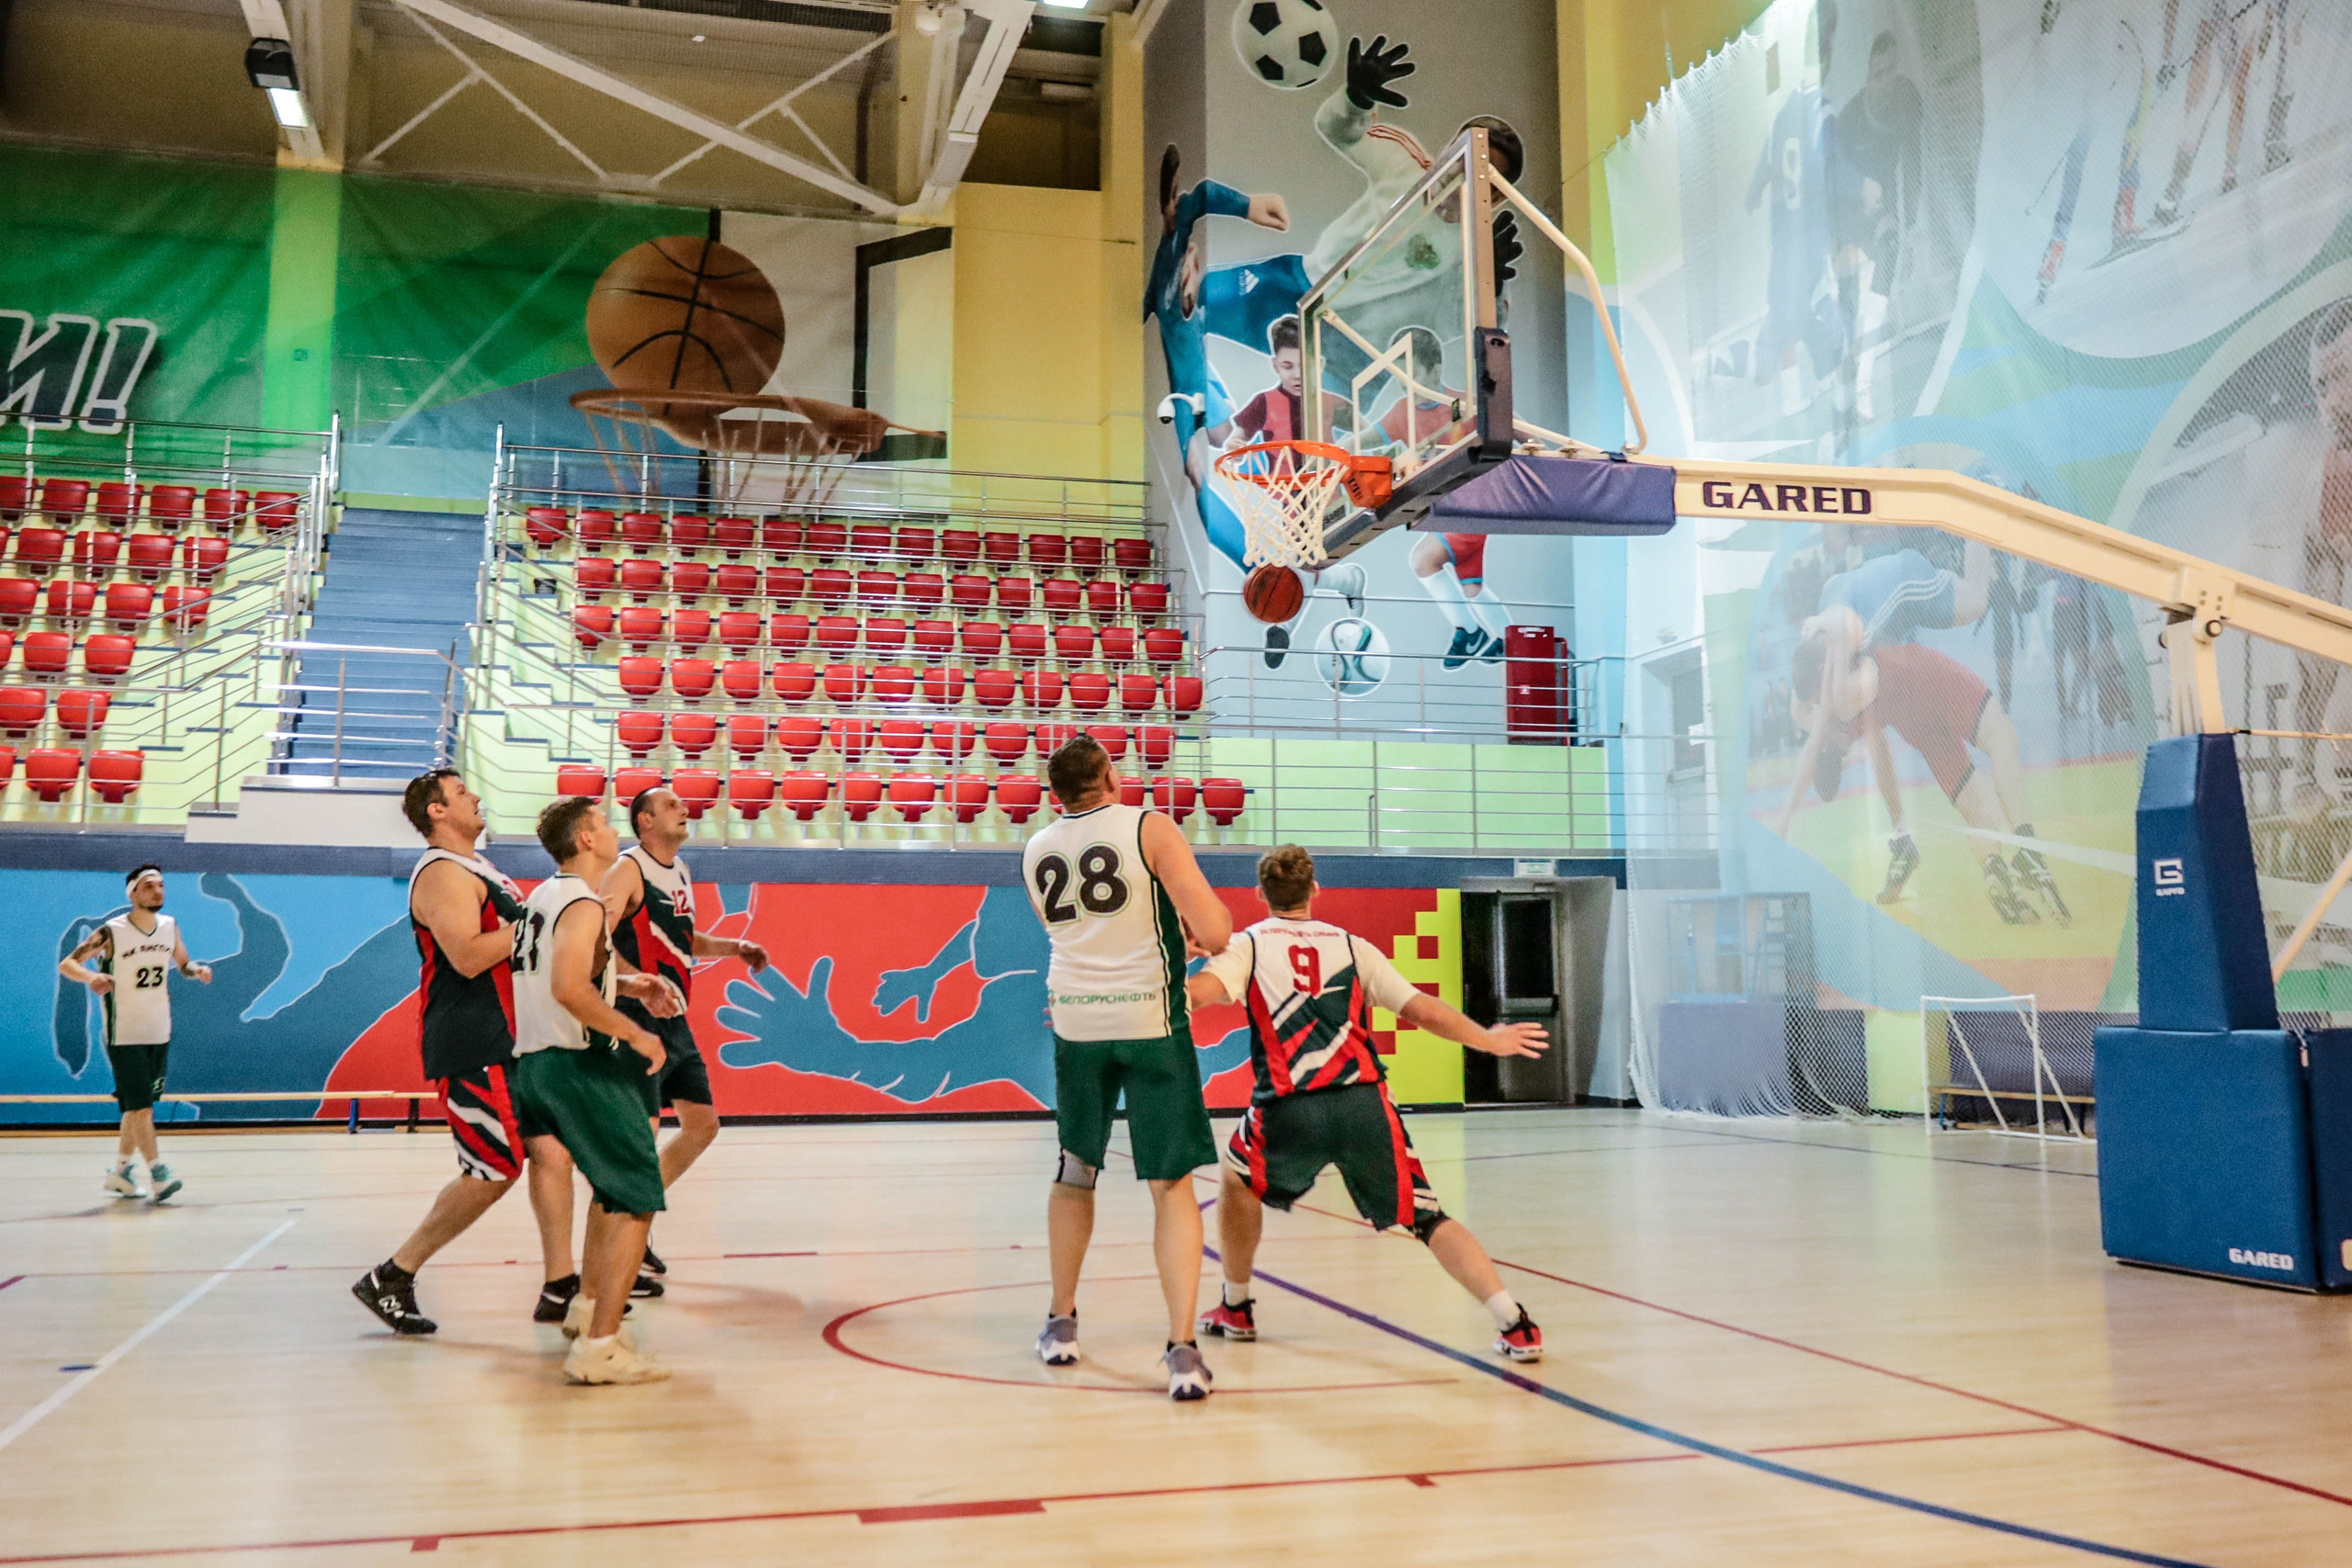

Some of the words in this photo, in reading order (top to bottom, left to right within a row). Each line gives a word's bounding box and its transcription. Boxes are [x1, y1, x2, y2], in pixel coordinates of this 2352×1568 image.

[1702, 480, 1871, 515] GARED
[1035, 844, 1129, 923] 28
[672, 889, 692, 915] 12
[135, 966, 164, 989] 23
[1288, 944, 1321, 998] 9
[2228, 1247, 2294, 1270] GARED
